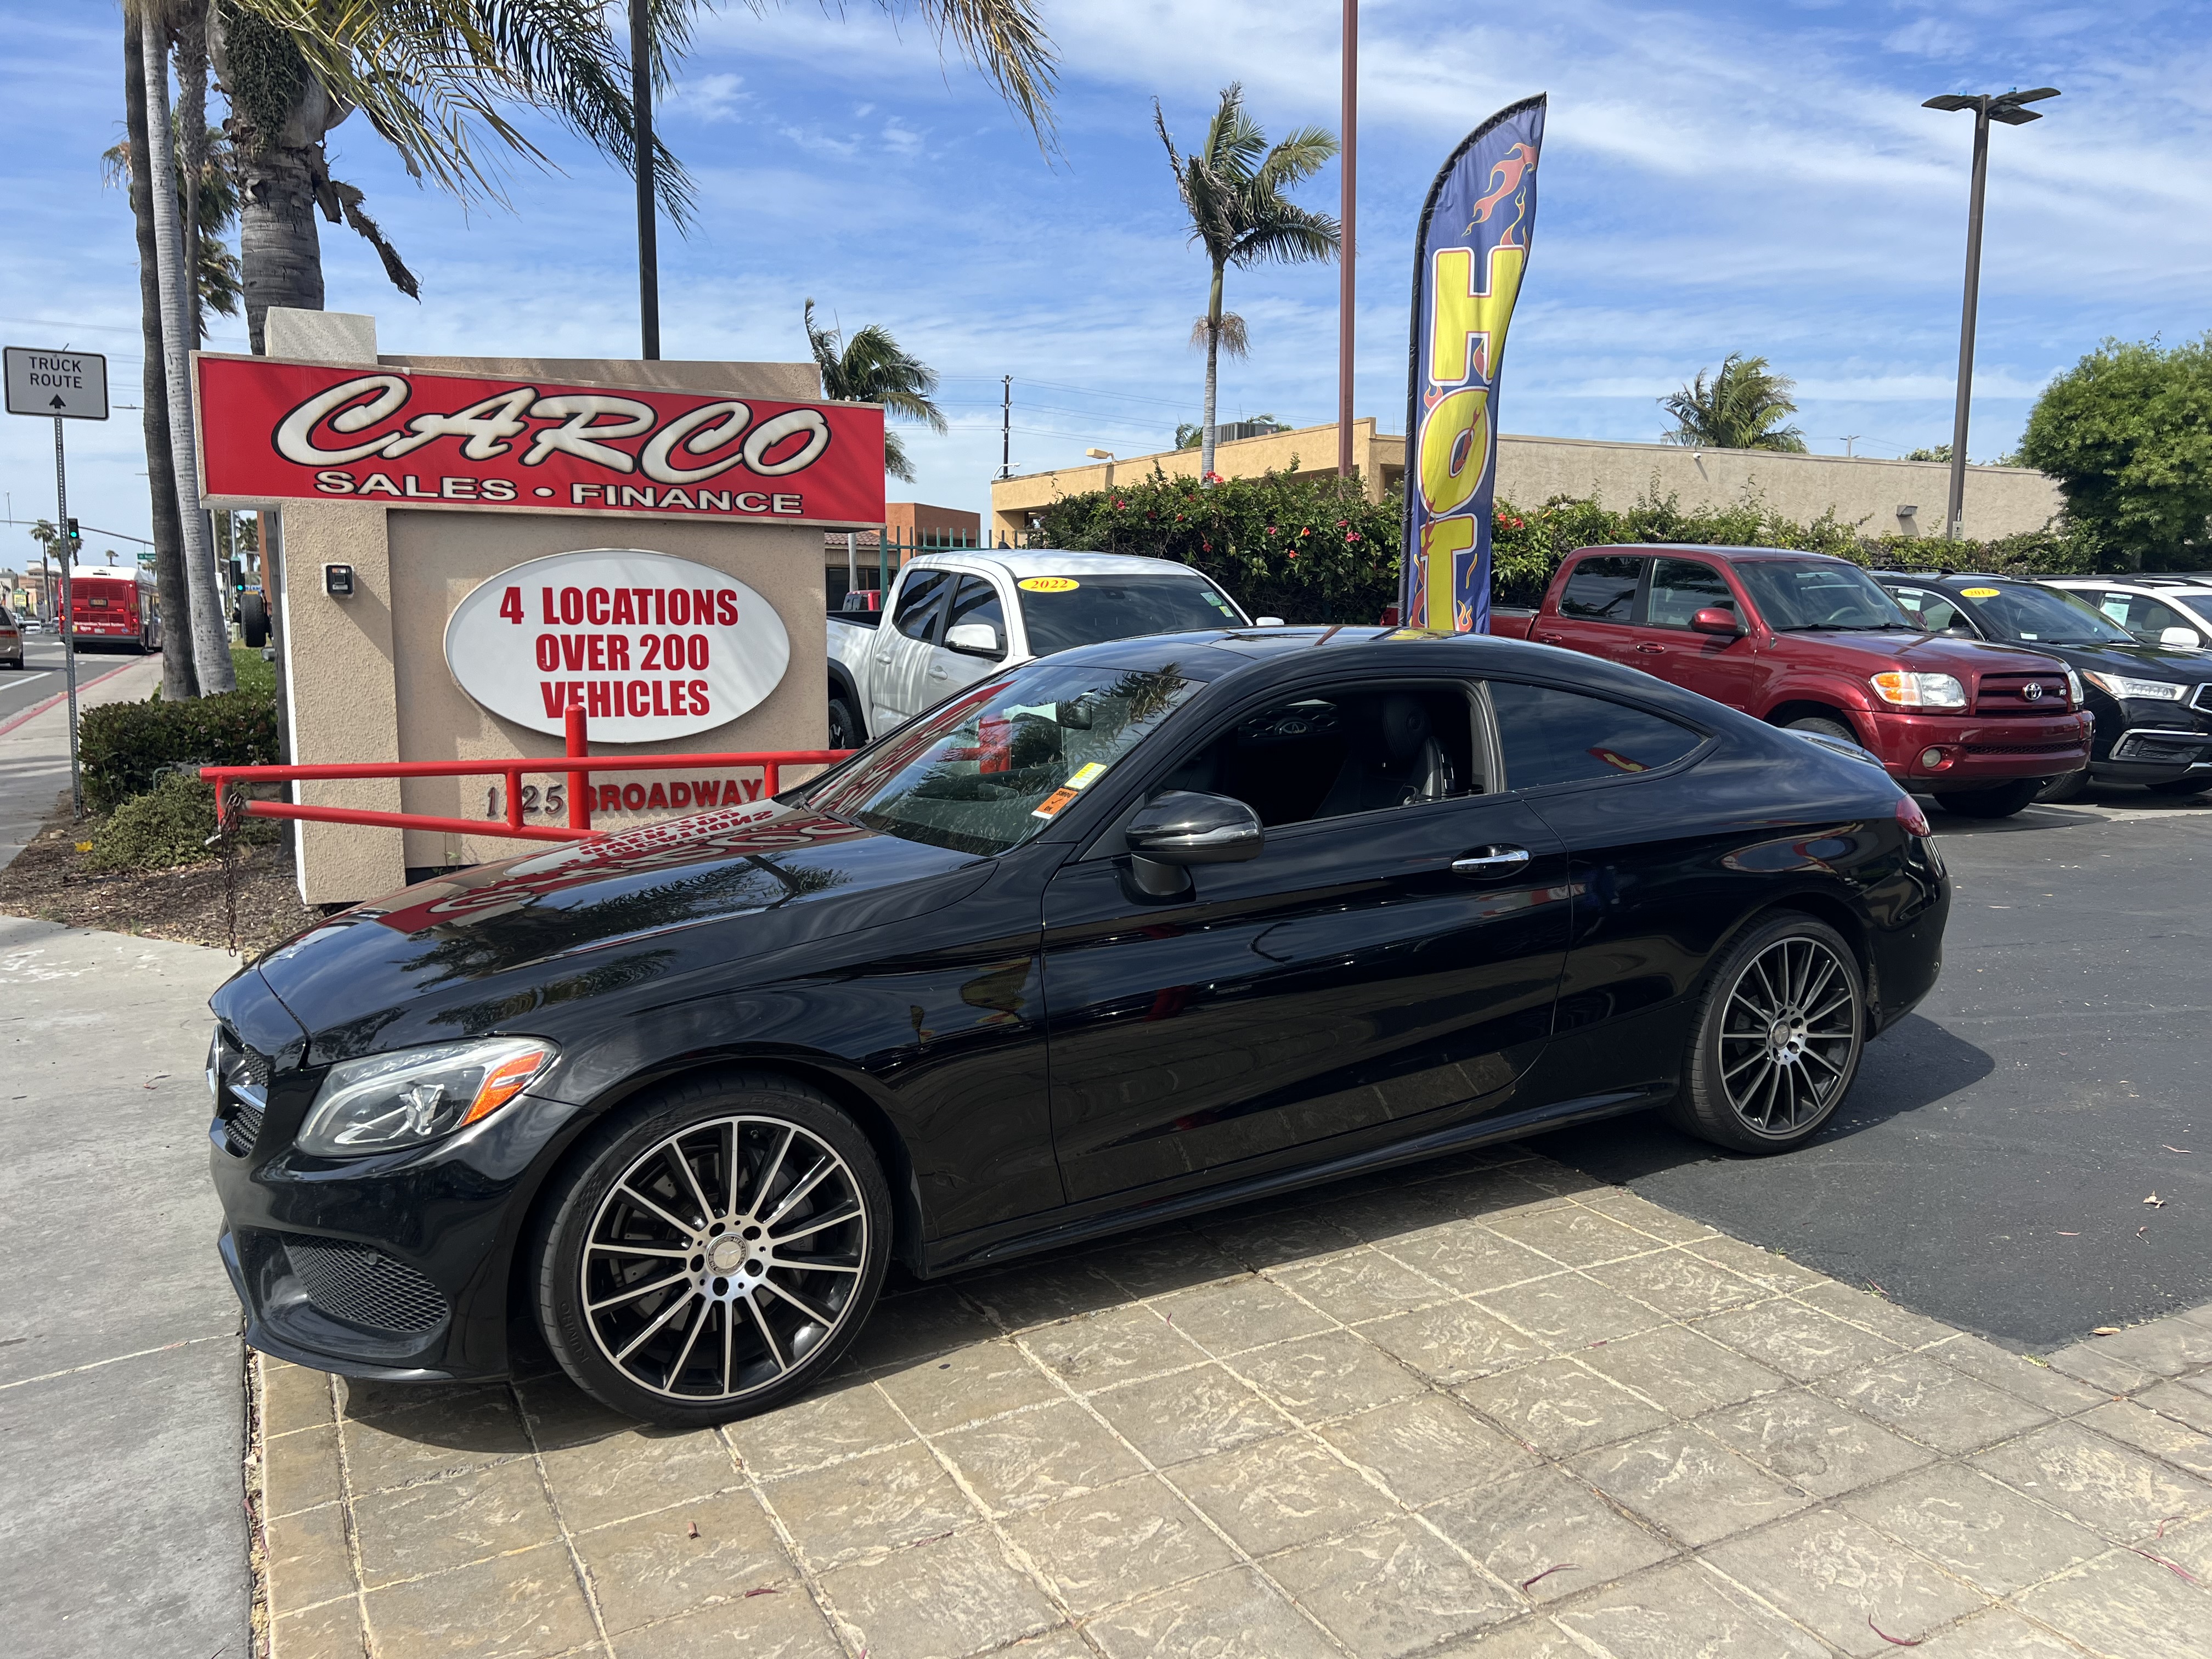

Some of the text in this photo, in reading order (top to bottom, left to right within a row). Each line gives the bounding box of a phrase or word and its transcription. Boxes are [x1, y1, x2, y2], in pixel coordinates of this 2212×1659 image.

[29, 356, 82, 373] TRUCK
[30, 373, 83, 389] ROUTE
[272, 375, 832, 484] CARCO
[1418, 244, 1527, 630] HOT
[315, 470, 804, 515] SALES FINANCE
[1030, 580, 1068, 589] 2022
[499, 586, 738, 626] 4 LOCATIONS
[535, 634, 710, 672] OVER 200
[540, 679, 710, 719] VEHICLES
[487, 784, 562, 816] 125
[561, 1302, 590, 1364] KUMHO
